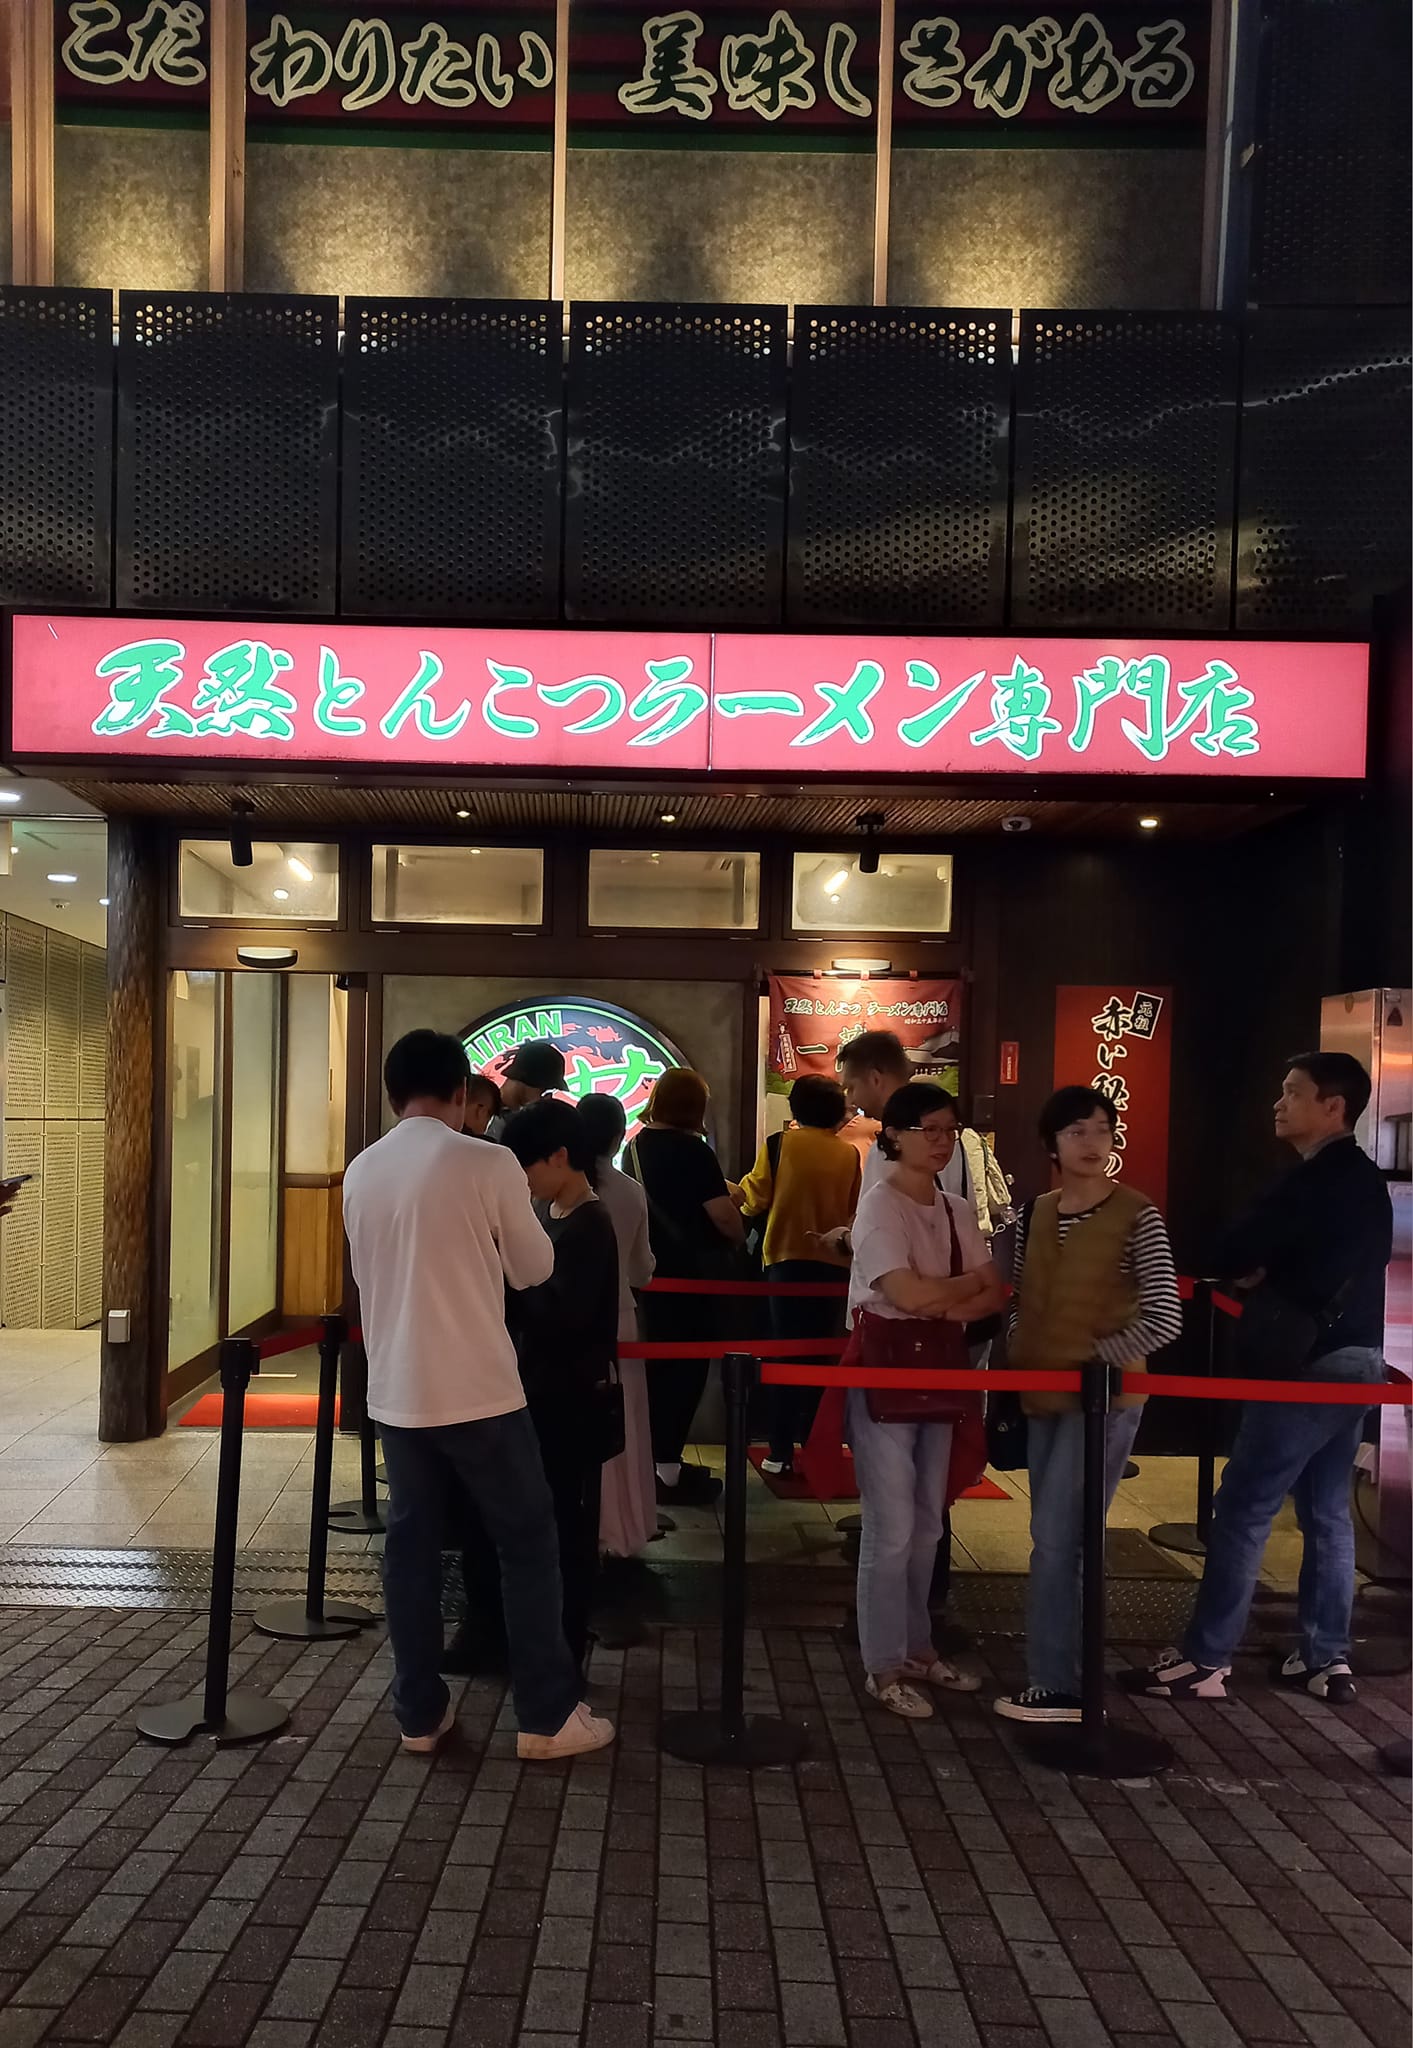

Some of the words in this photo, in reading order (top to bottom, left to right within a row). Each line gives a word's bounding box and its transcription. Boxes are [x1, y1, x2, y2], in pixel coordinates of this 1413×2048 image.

[62, 0, 553, 107] こだわりたい
[618, 10, 1195, 120] 美味しさがある
[92, 638, 1260, 761] 天然とんこつラーメン専門店
